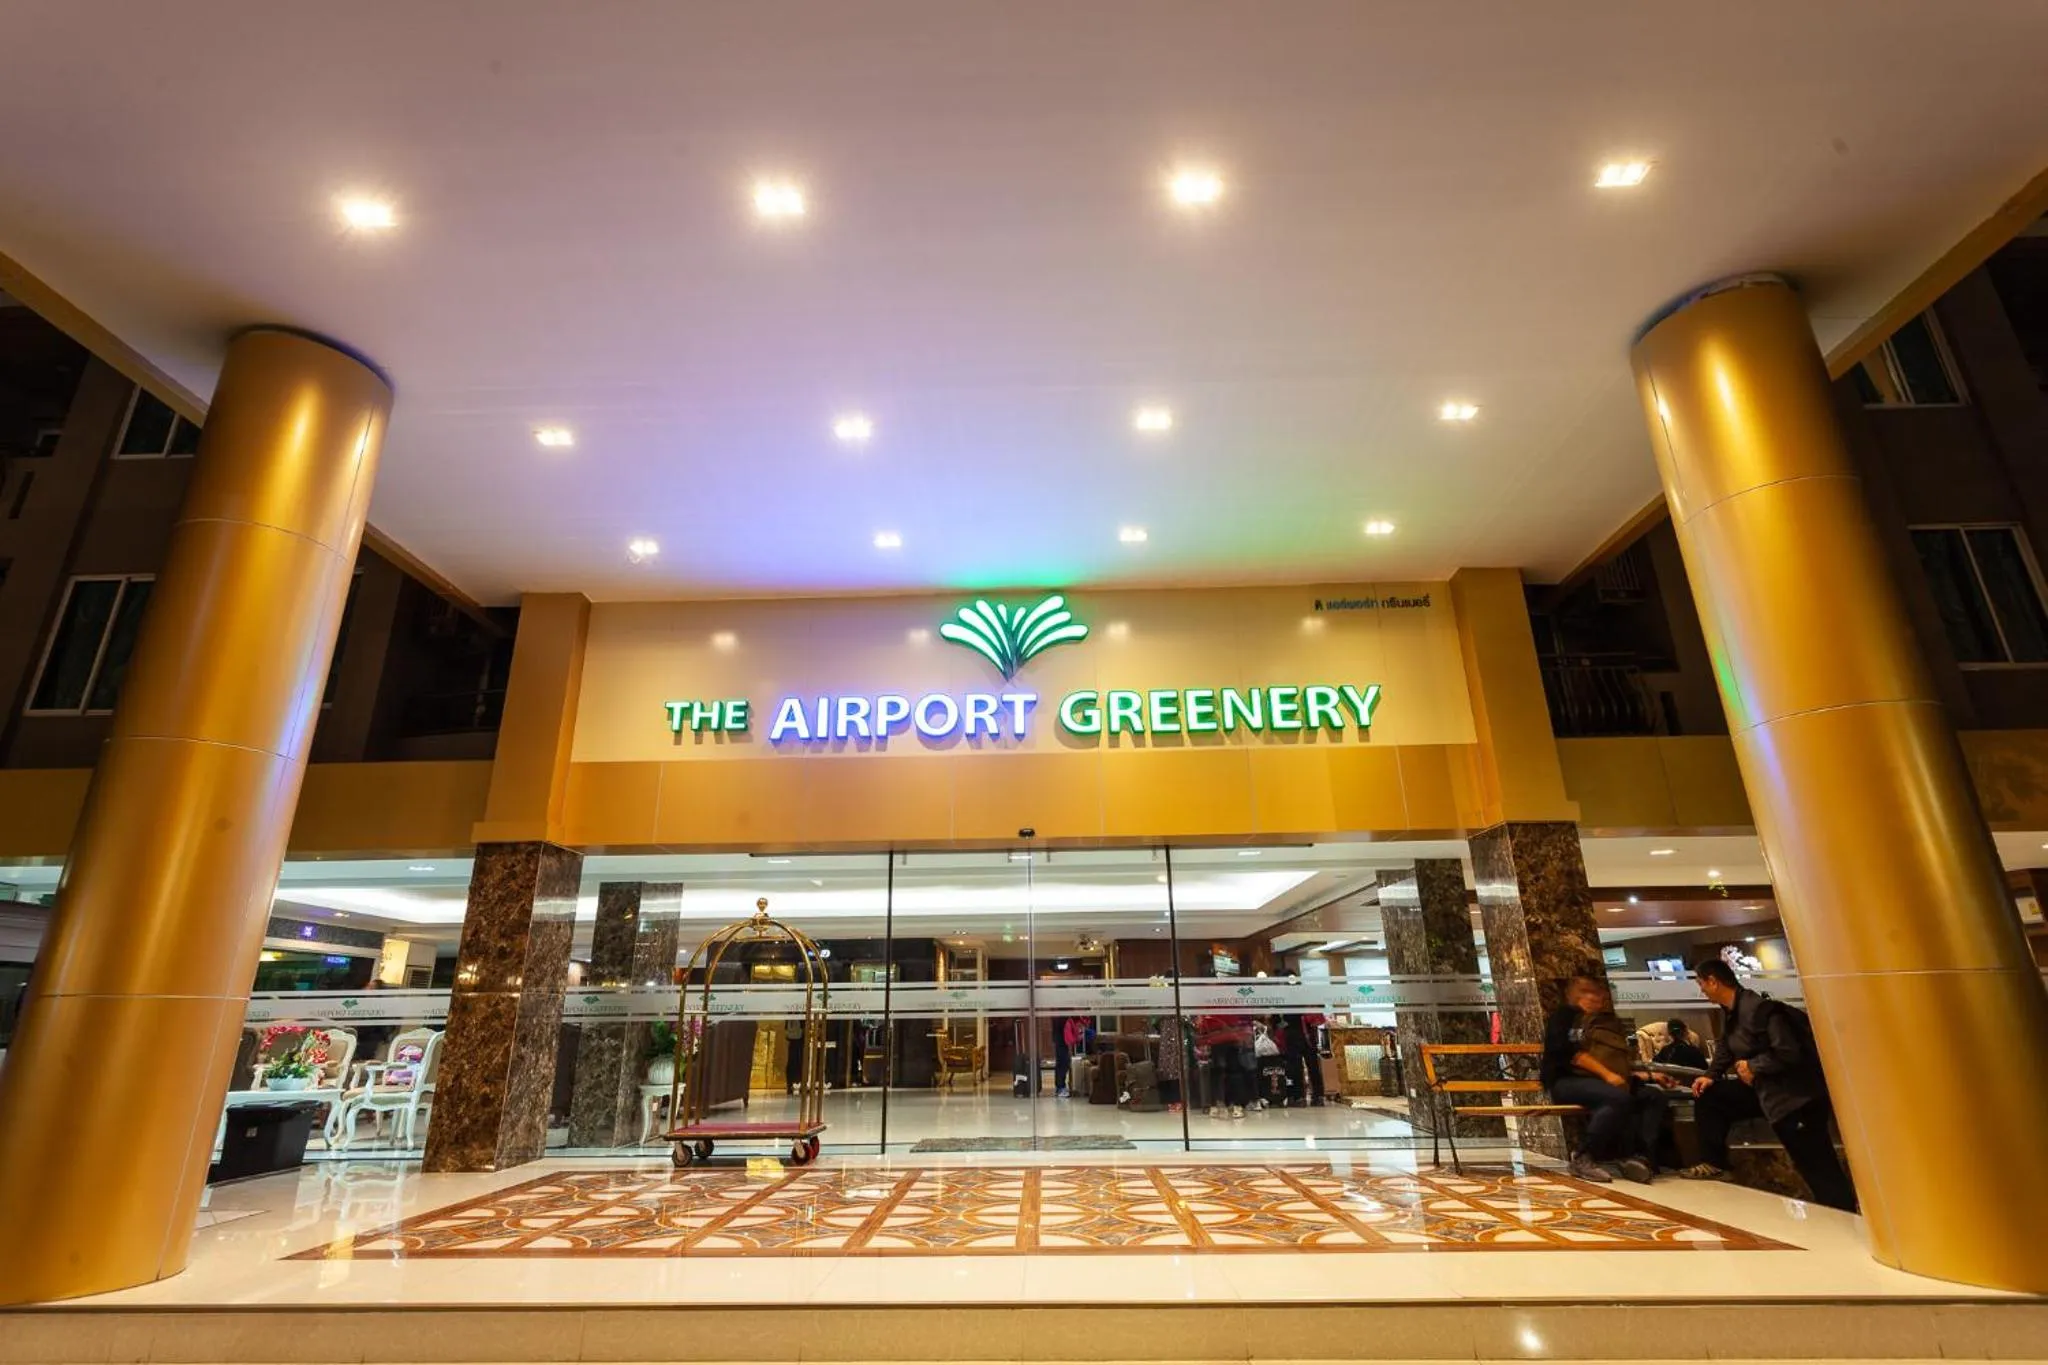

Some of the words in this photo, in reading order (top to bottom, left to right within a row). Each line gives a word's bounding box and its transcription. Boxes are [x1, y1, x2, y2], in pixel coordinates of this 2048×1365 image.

[664, 699, 748, 732] THE
[769, 694, 1037, 740] AIRPORT
[1059, 685, 1381, 734] GREENERY
